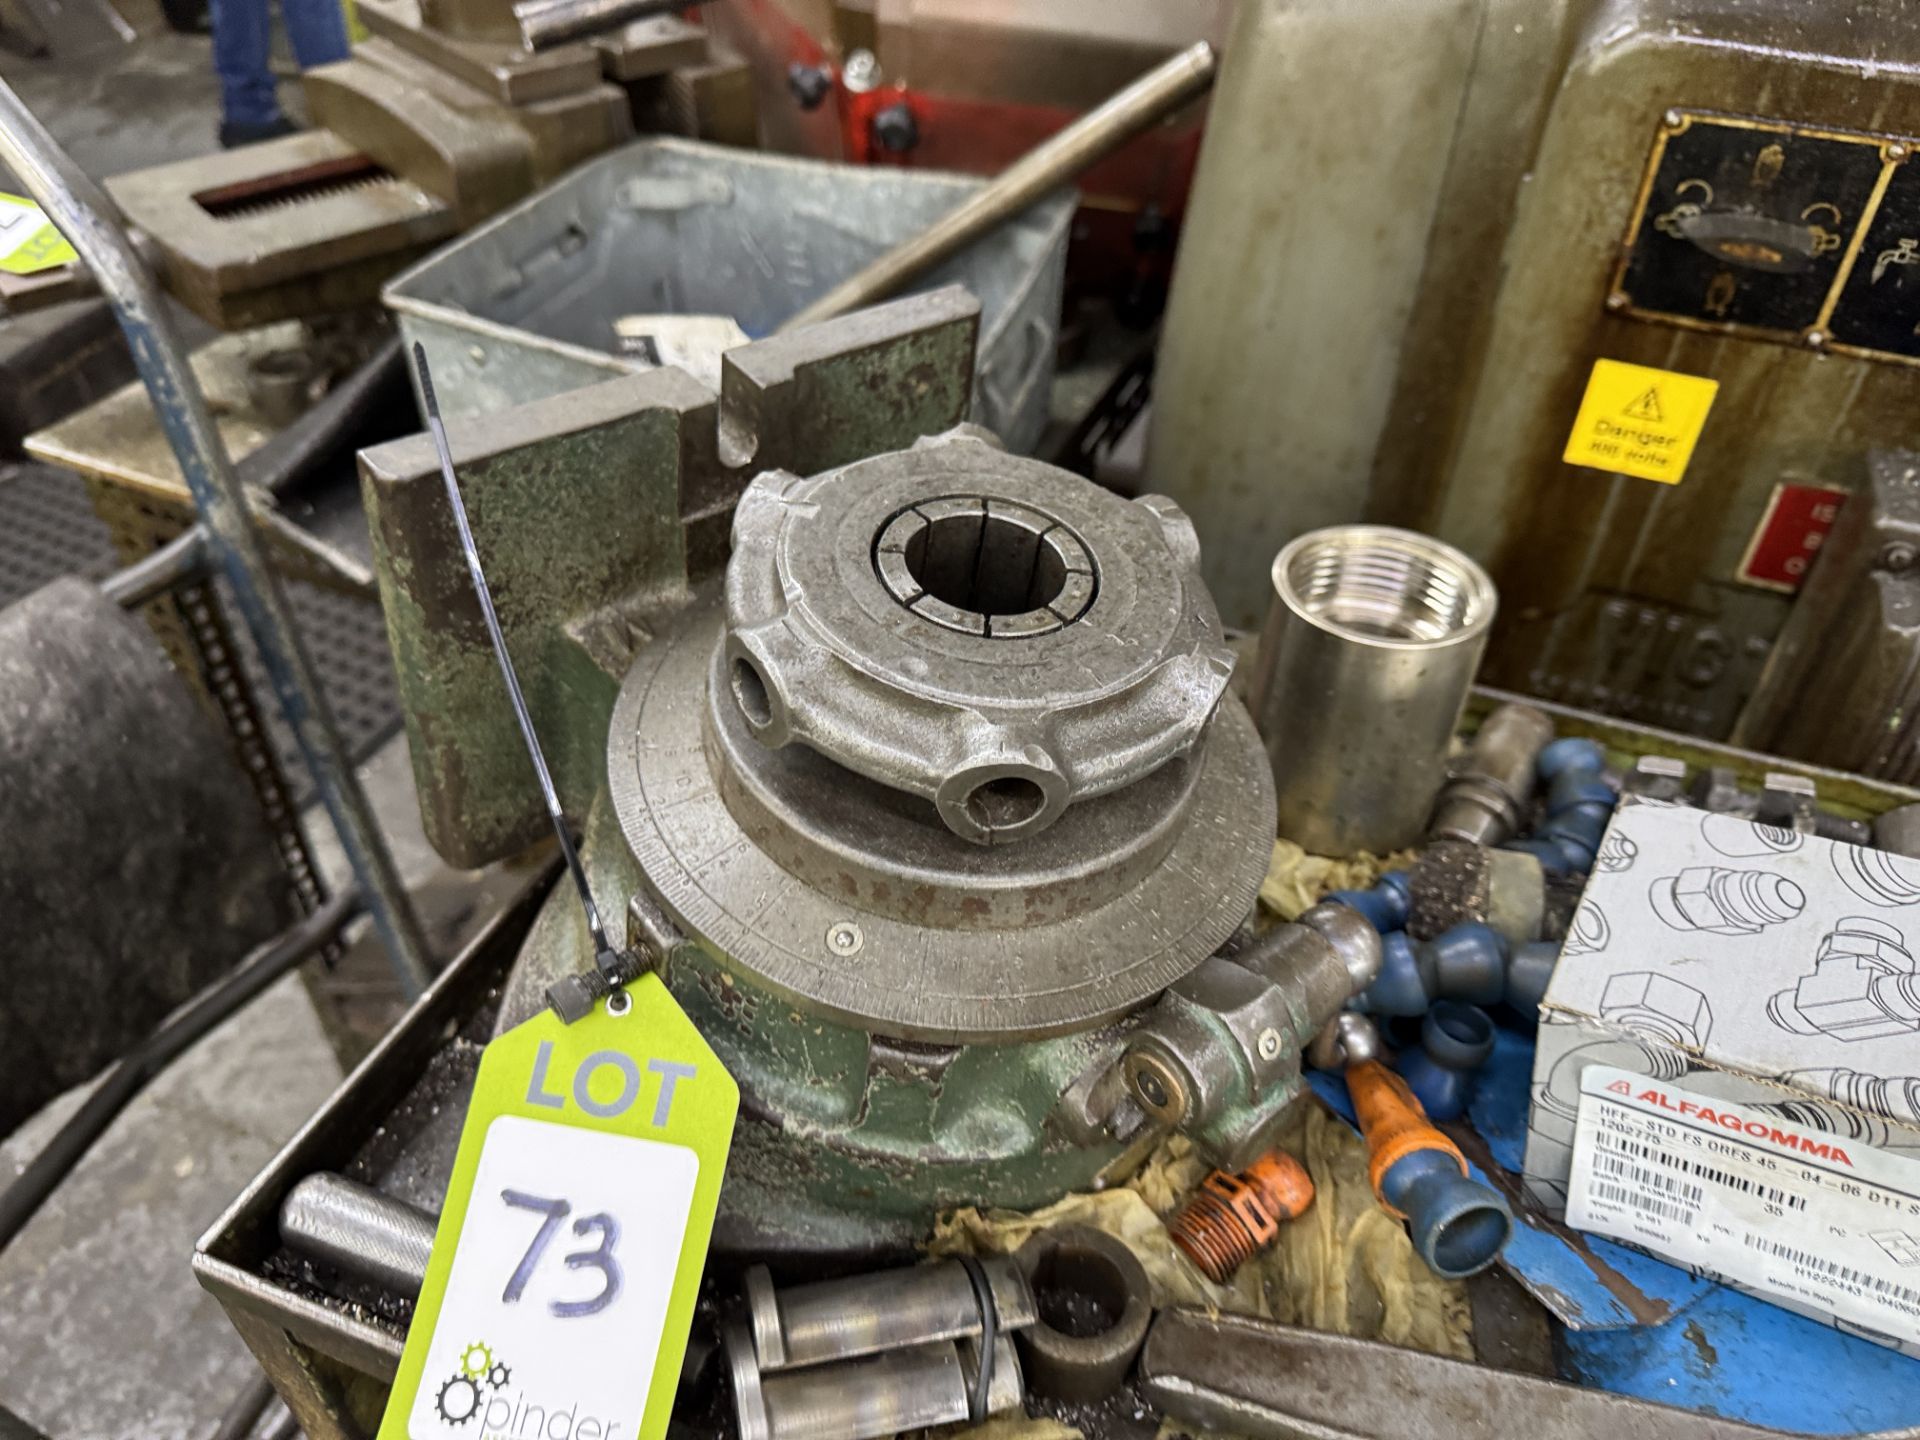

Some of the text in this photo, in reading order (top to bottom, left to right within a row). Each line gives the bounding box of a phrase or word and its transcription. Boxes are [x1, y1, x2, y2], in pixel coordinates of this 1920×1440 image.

[1593, 419, 1679, 447] Danger
[525, 1040, 696, 1128] LOT
[1636, 1089, 1855, 1168] ALFAGOMMA
[1757, 1156, 1777, 1171] 45
[499, 1187, 626, 1319] 73
[479, 1390, 621, 1440] pinder
